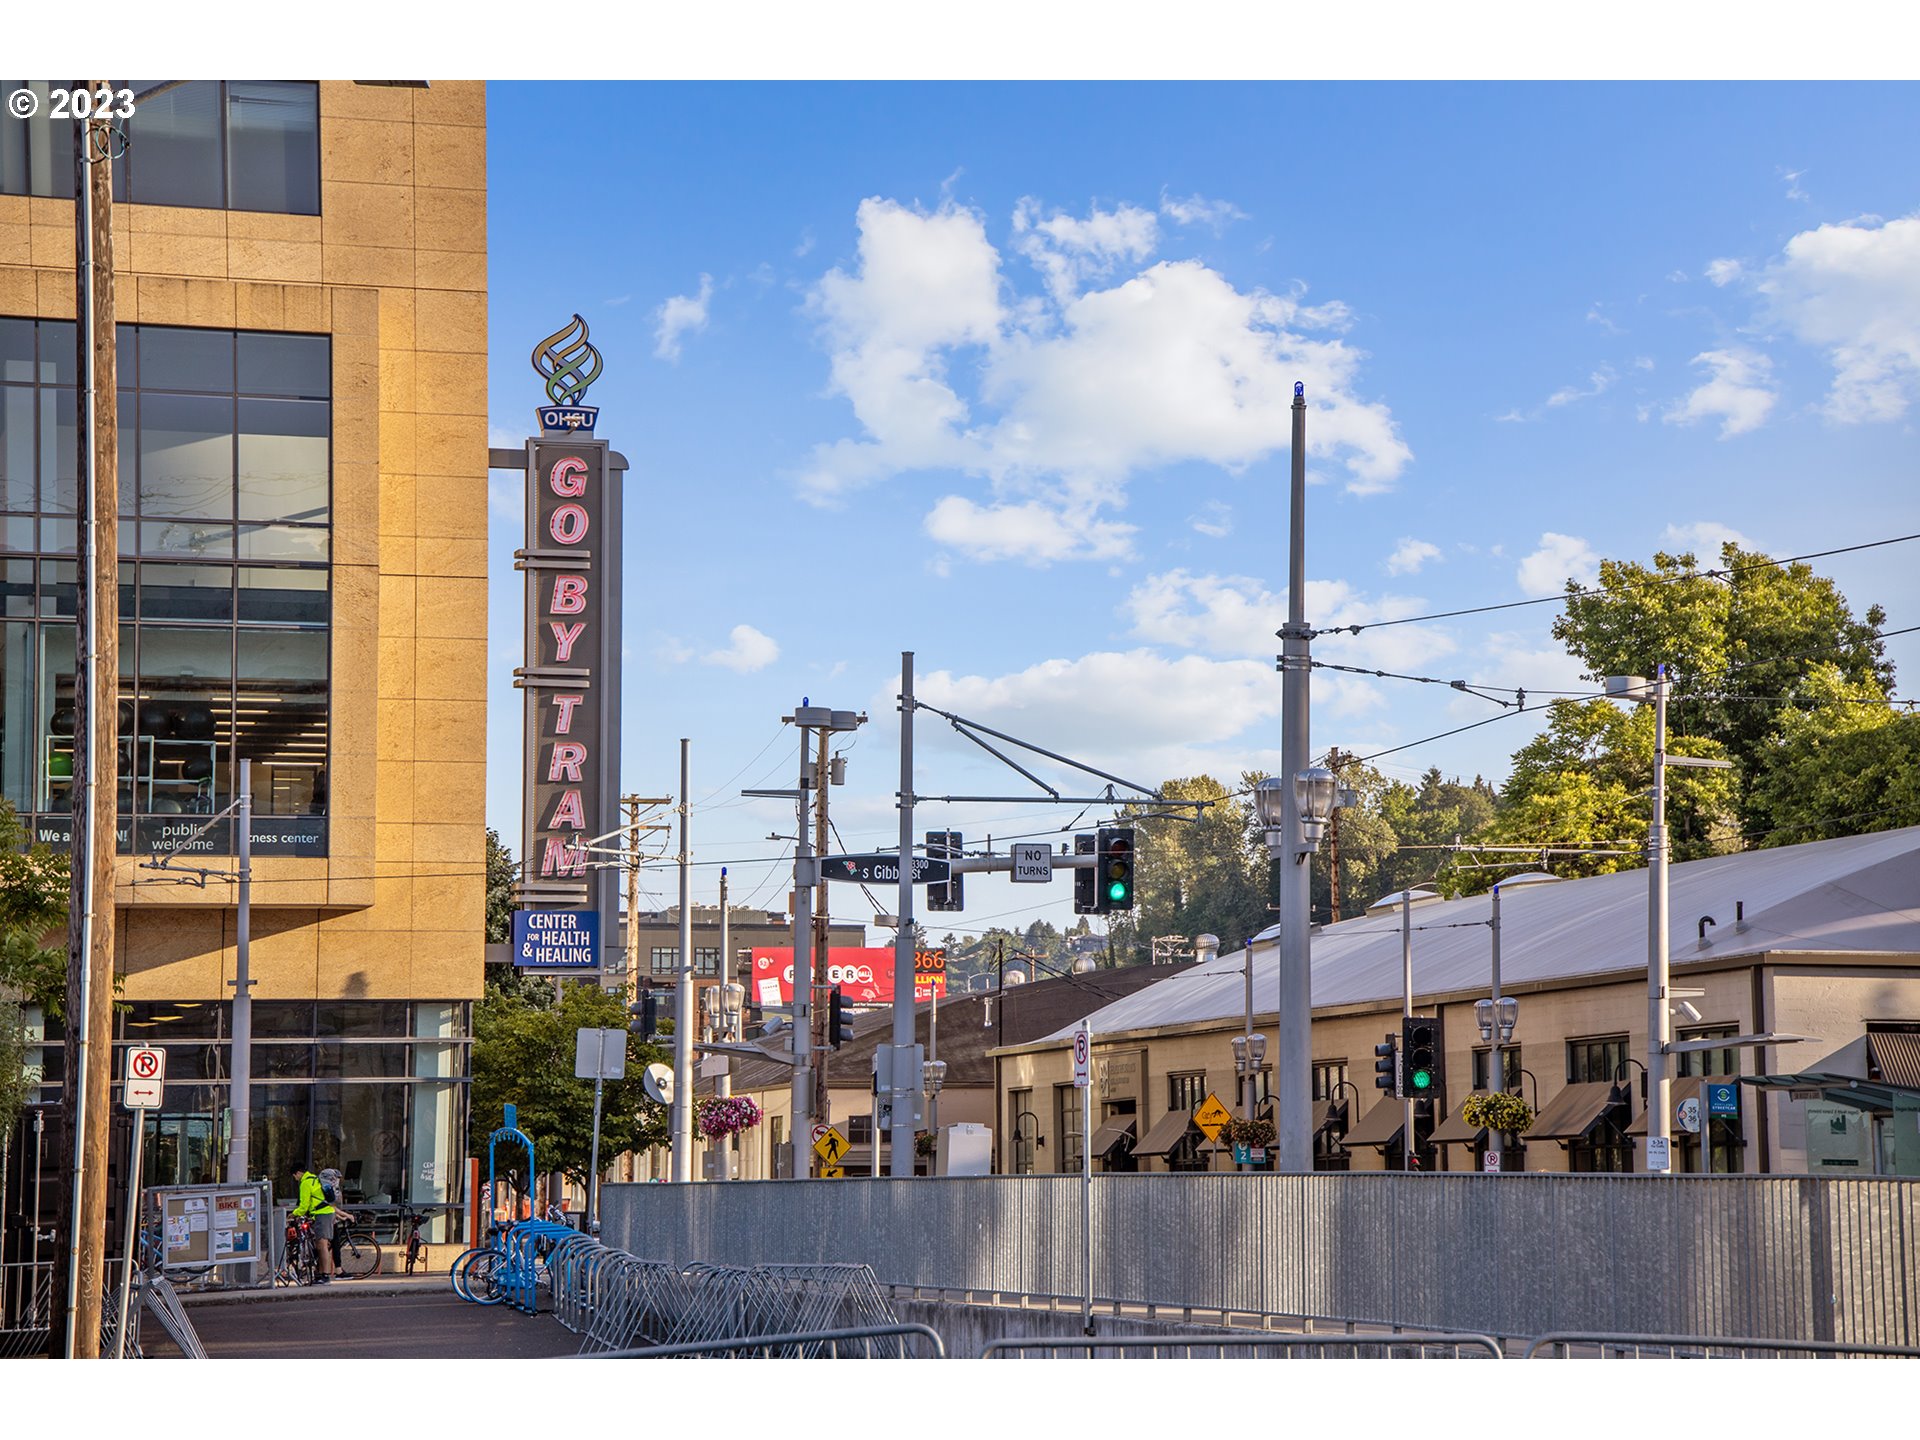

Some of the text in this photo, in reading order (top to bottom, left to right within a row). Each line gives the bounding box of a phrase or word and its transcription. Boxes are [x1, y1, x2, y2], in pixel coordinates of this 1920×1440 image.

[550, 456, 589, 545] GO
[549, 575, 588, 661] BY
[541, 694, 588, 877] TRAM
[39, 829, 54, 842] We
[162, 824, 205, 837] public
[152, 838, 214, 851] welcome
[281, 834, 319, 844] center
[1025, 850, 1042, 861] NO
[874, 865, 899, 880] Gibb
[1018, 866, 1049, 877] TURNS
[528, 914, 577, 929] CENTER
[527, 931, 590, 946] FOR HEALTH
[522, 942, 592, 963] & HEALING
[915, 976, 943, 984] LLION
[1240, 1151, 1247, 1160] 2
[218, 1201, 239, 1210] BIKE
